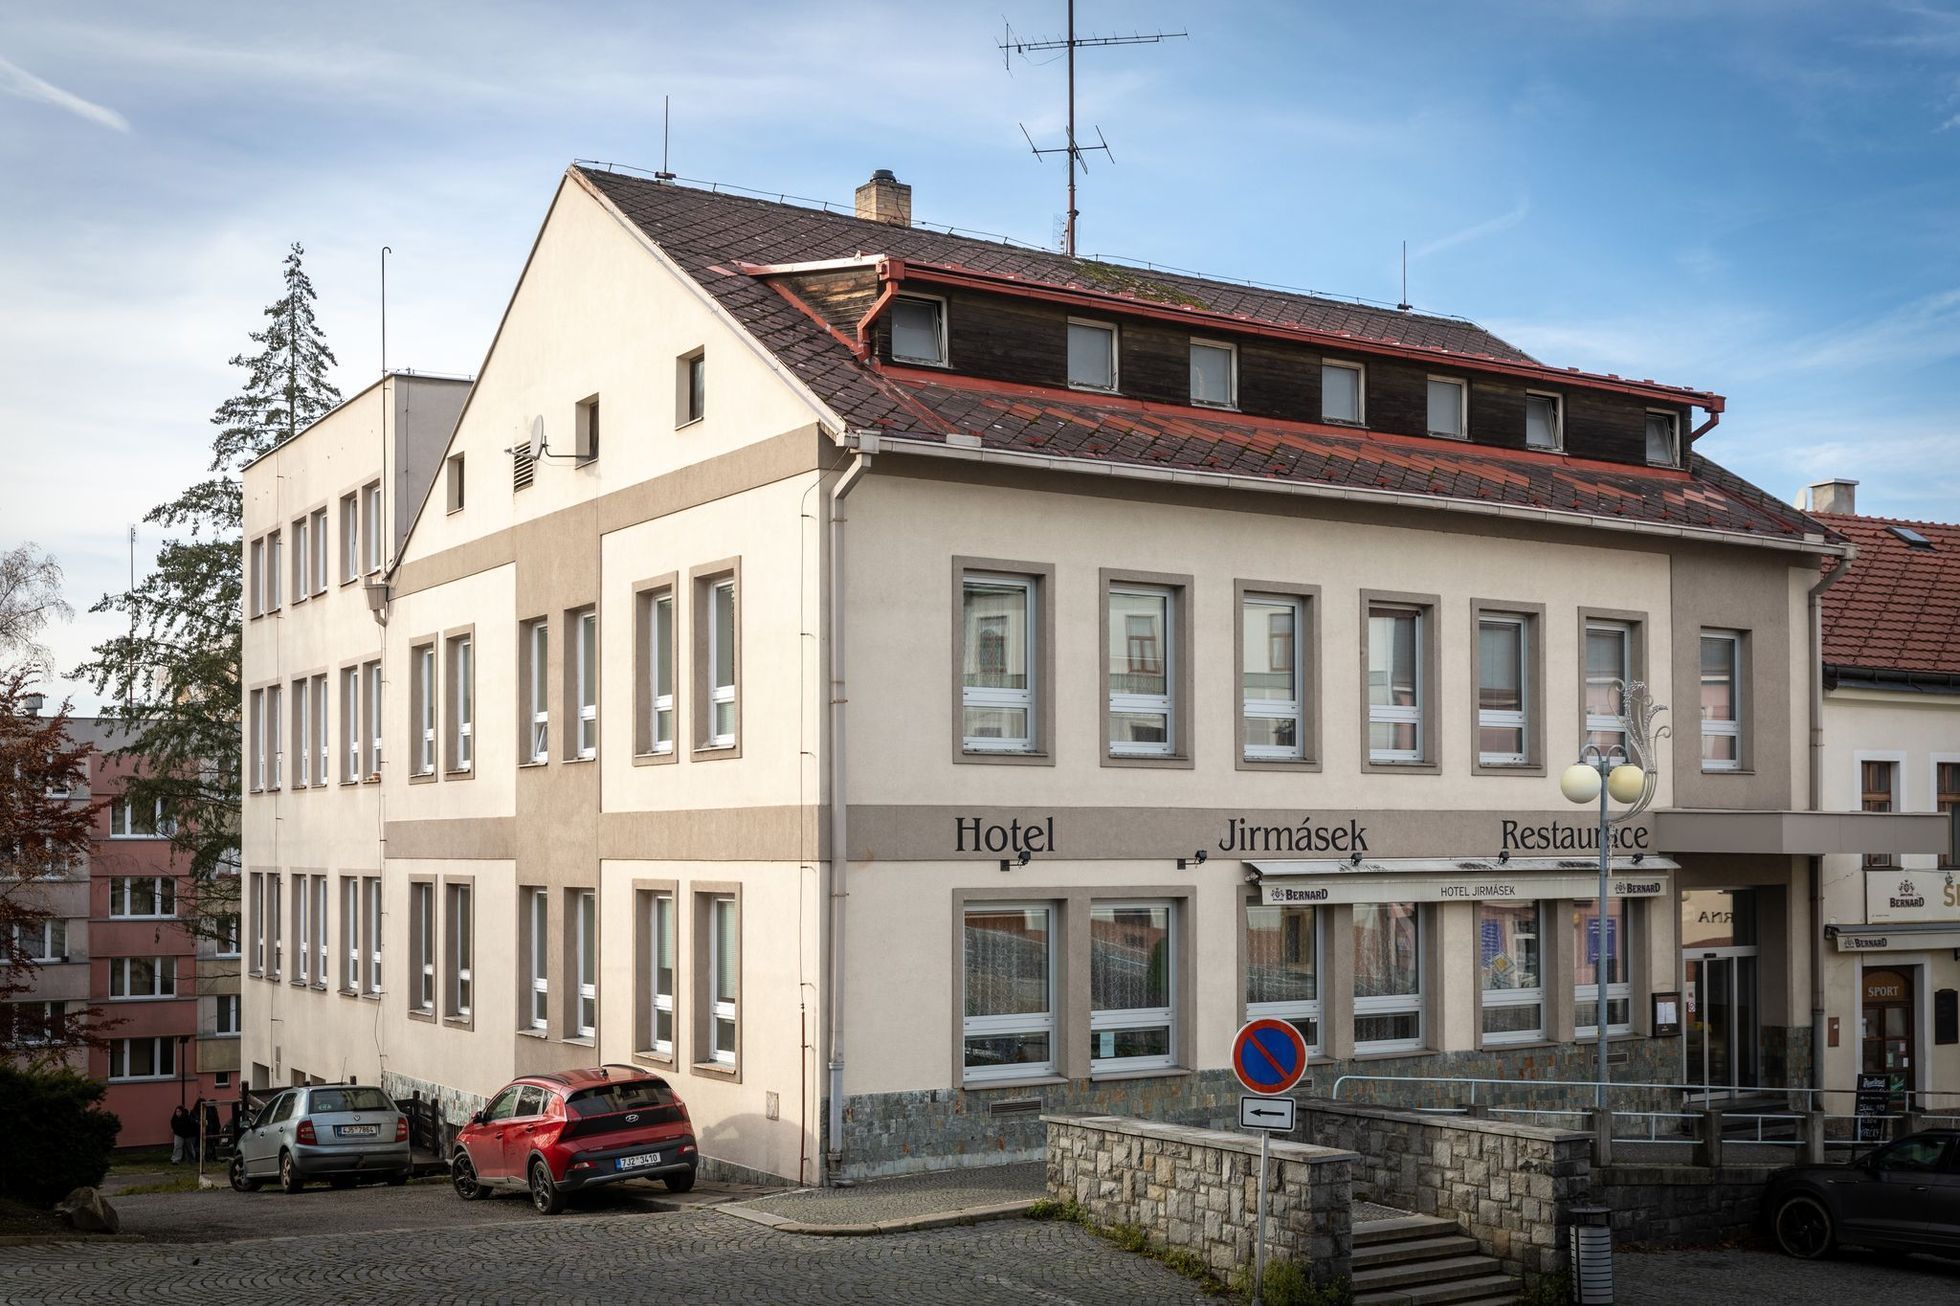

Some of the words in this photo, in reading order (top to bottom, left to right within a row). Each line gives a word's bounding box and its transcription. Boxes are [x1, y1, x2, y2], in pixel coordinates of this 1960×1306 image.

[954, 816, 1056, 853] Hotel
[1218, 816, 1369, 853] Jirmásek
[1440, 886, 1470, 897] HOTEL
[1471, 883, 1516, 897] JIRMÁSEK
[1626, 882, 1661, 894] BERNARD
[1285, 888, 1329, 901] BERNARD
[1889, 896, 1925, 908] BERNARD
[1854, 937, 1888, 949] BERNARD
[1868, 986, 1899, 997] SPORT
[639, 1153, 658, 1165] 3410
